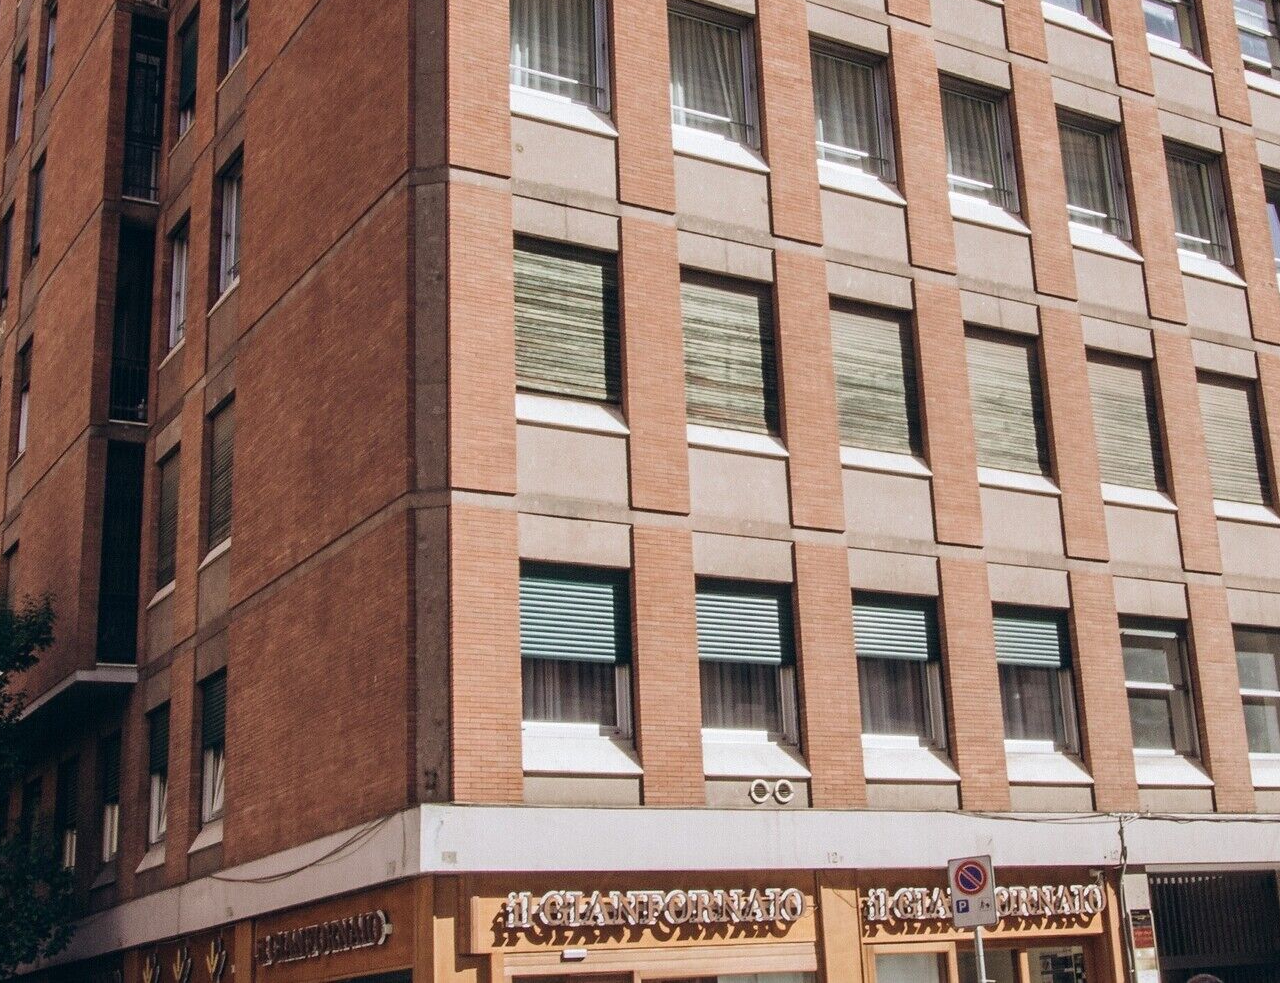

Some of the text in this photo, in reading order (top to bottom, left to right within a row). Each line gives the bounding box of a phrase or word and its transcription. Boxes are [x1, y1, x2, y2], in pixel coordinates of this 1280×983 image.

[506, 888, 808, 928] il GIANFORNAIO
[892, 884, 1108, 920] GIAORNAIO
